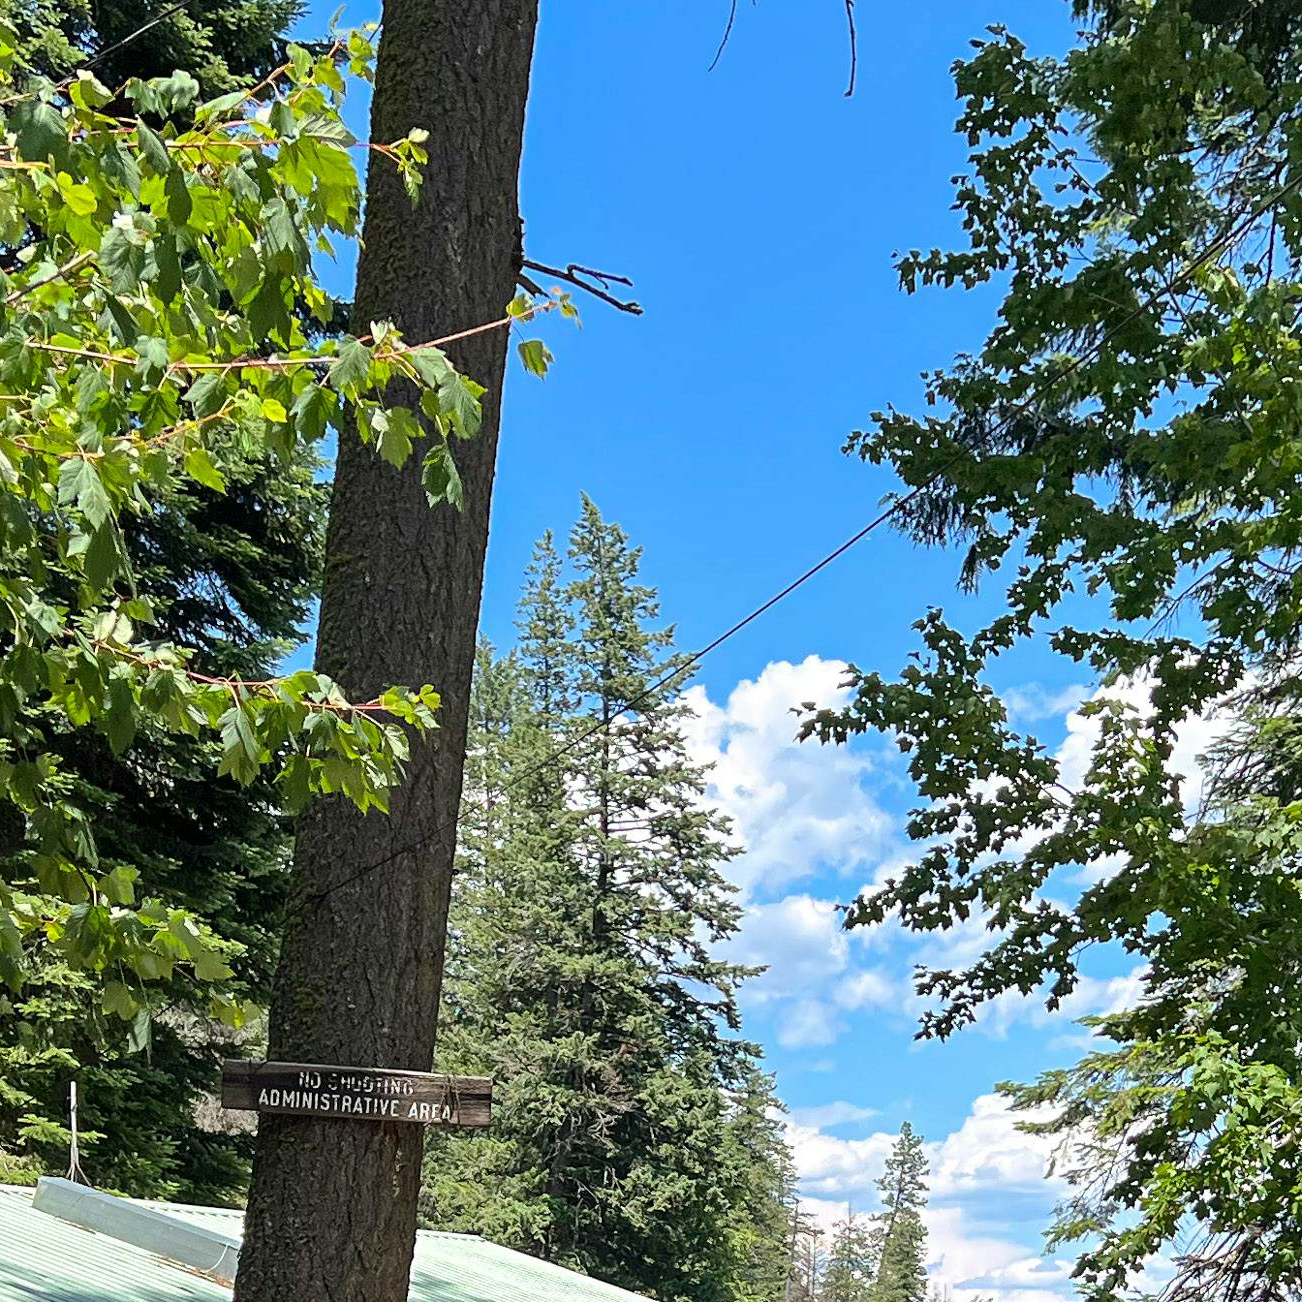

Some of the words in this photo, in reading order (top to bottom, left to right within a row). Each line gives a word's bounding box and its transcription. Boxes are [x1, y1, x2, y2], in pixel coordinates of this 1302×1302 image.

[298, 1071, 321, 1089] NO
[258, 1088, 400, 1117] ADMINISTRATIVE
[407, 1101, 452, 1121] AREA
